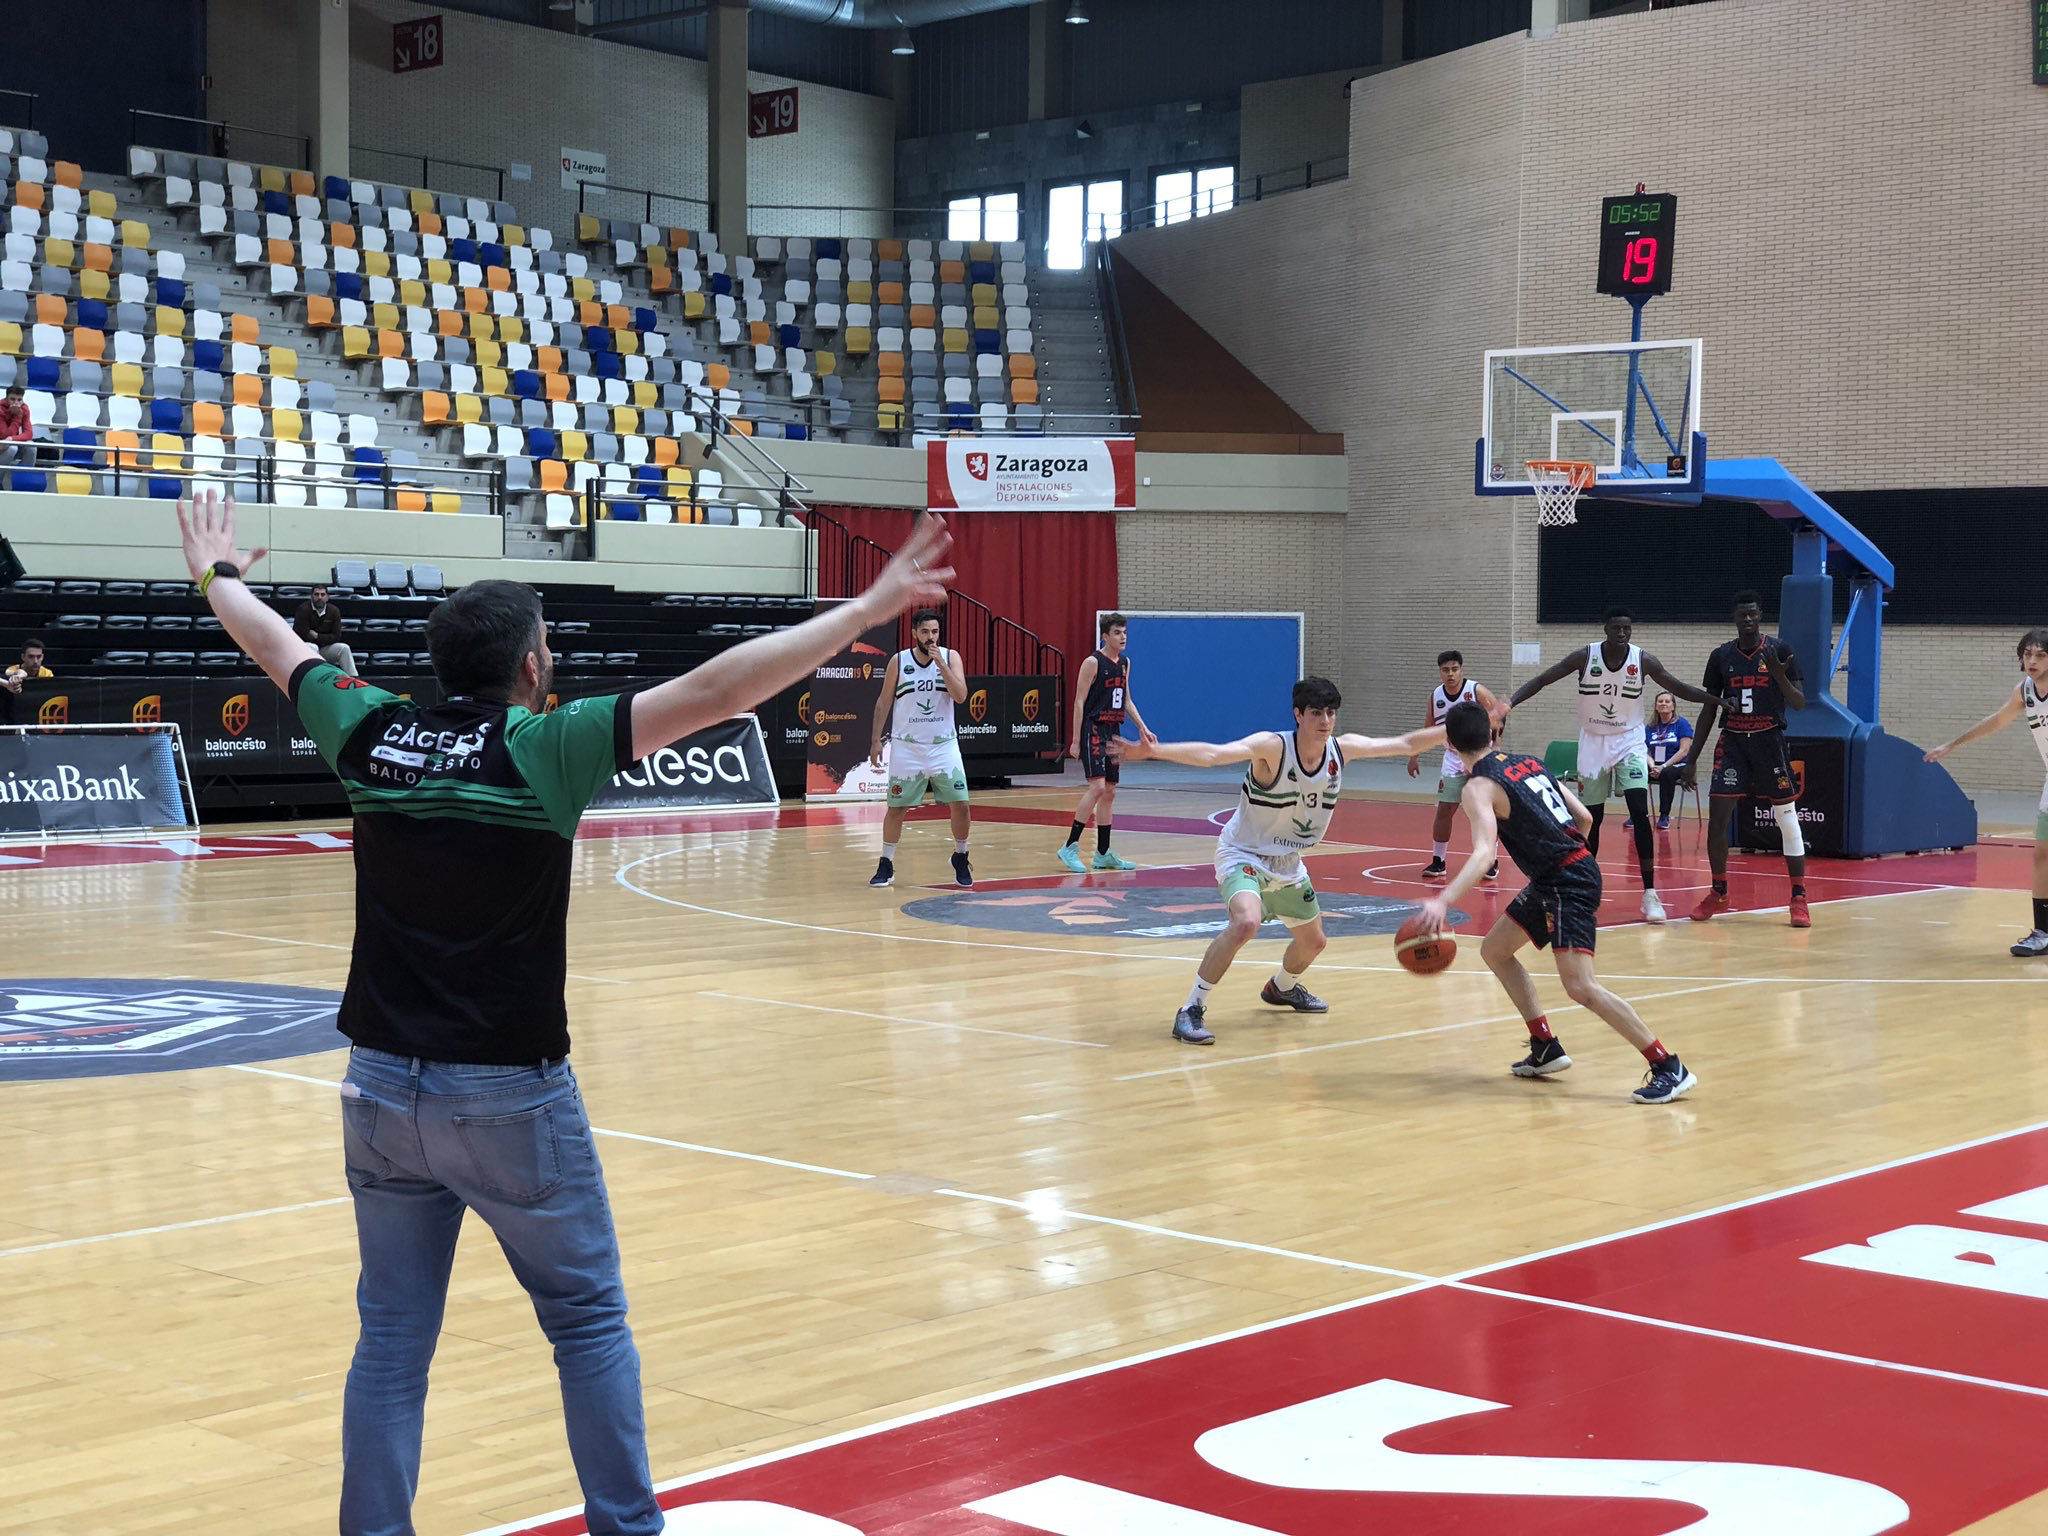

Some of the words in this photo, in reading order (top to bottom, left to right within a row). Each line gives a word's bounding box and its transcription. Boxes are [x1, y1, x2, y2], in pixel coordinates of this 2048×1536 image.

[414, 23, 438, 61] 18
[771, 94, 794, 129] 19
[572, 160, 606, 175] Zaragoza
[1609, 202, 1661, 224] 05:52
[1623, 237, 1657, 284] 19
[996, 455, 1088, 477] Zaragoza
[996, 481, 1073, 491] INSTALACIONES
[996, 492, 1059, 501] DEPORTIVAS
[917, 679, 934, 692] 20
[1603, 683, 1618, 696] 21
[1729, 676, 1769, 688] CBZ
[1741, 688, 1754, 713] 5
[908, 716, 944, 724] Extremadura
